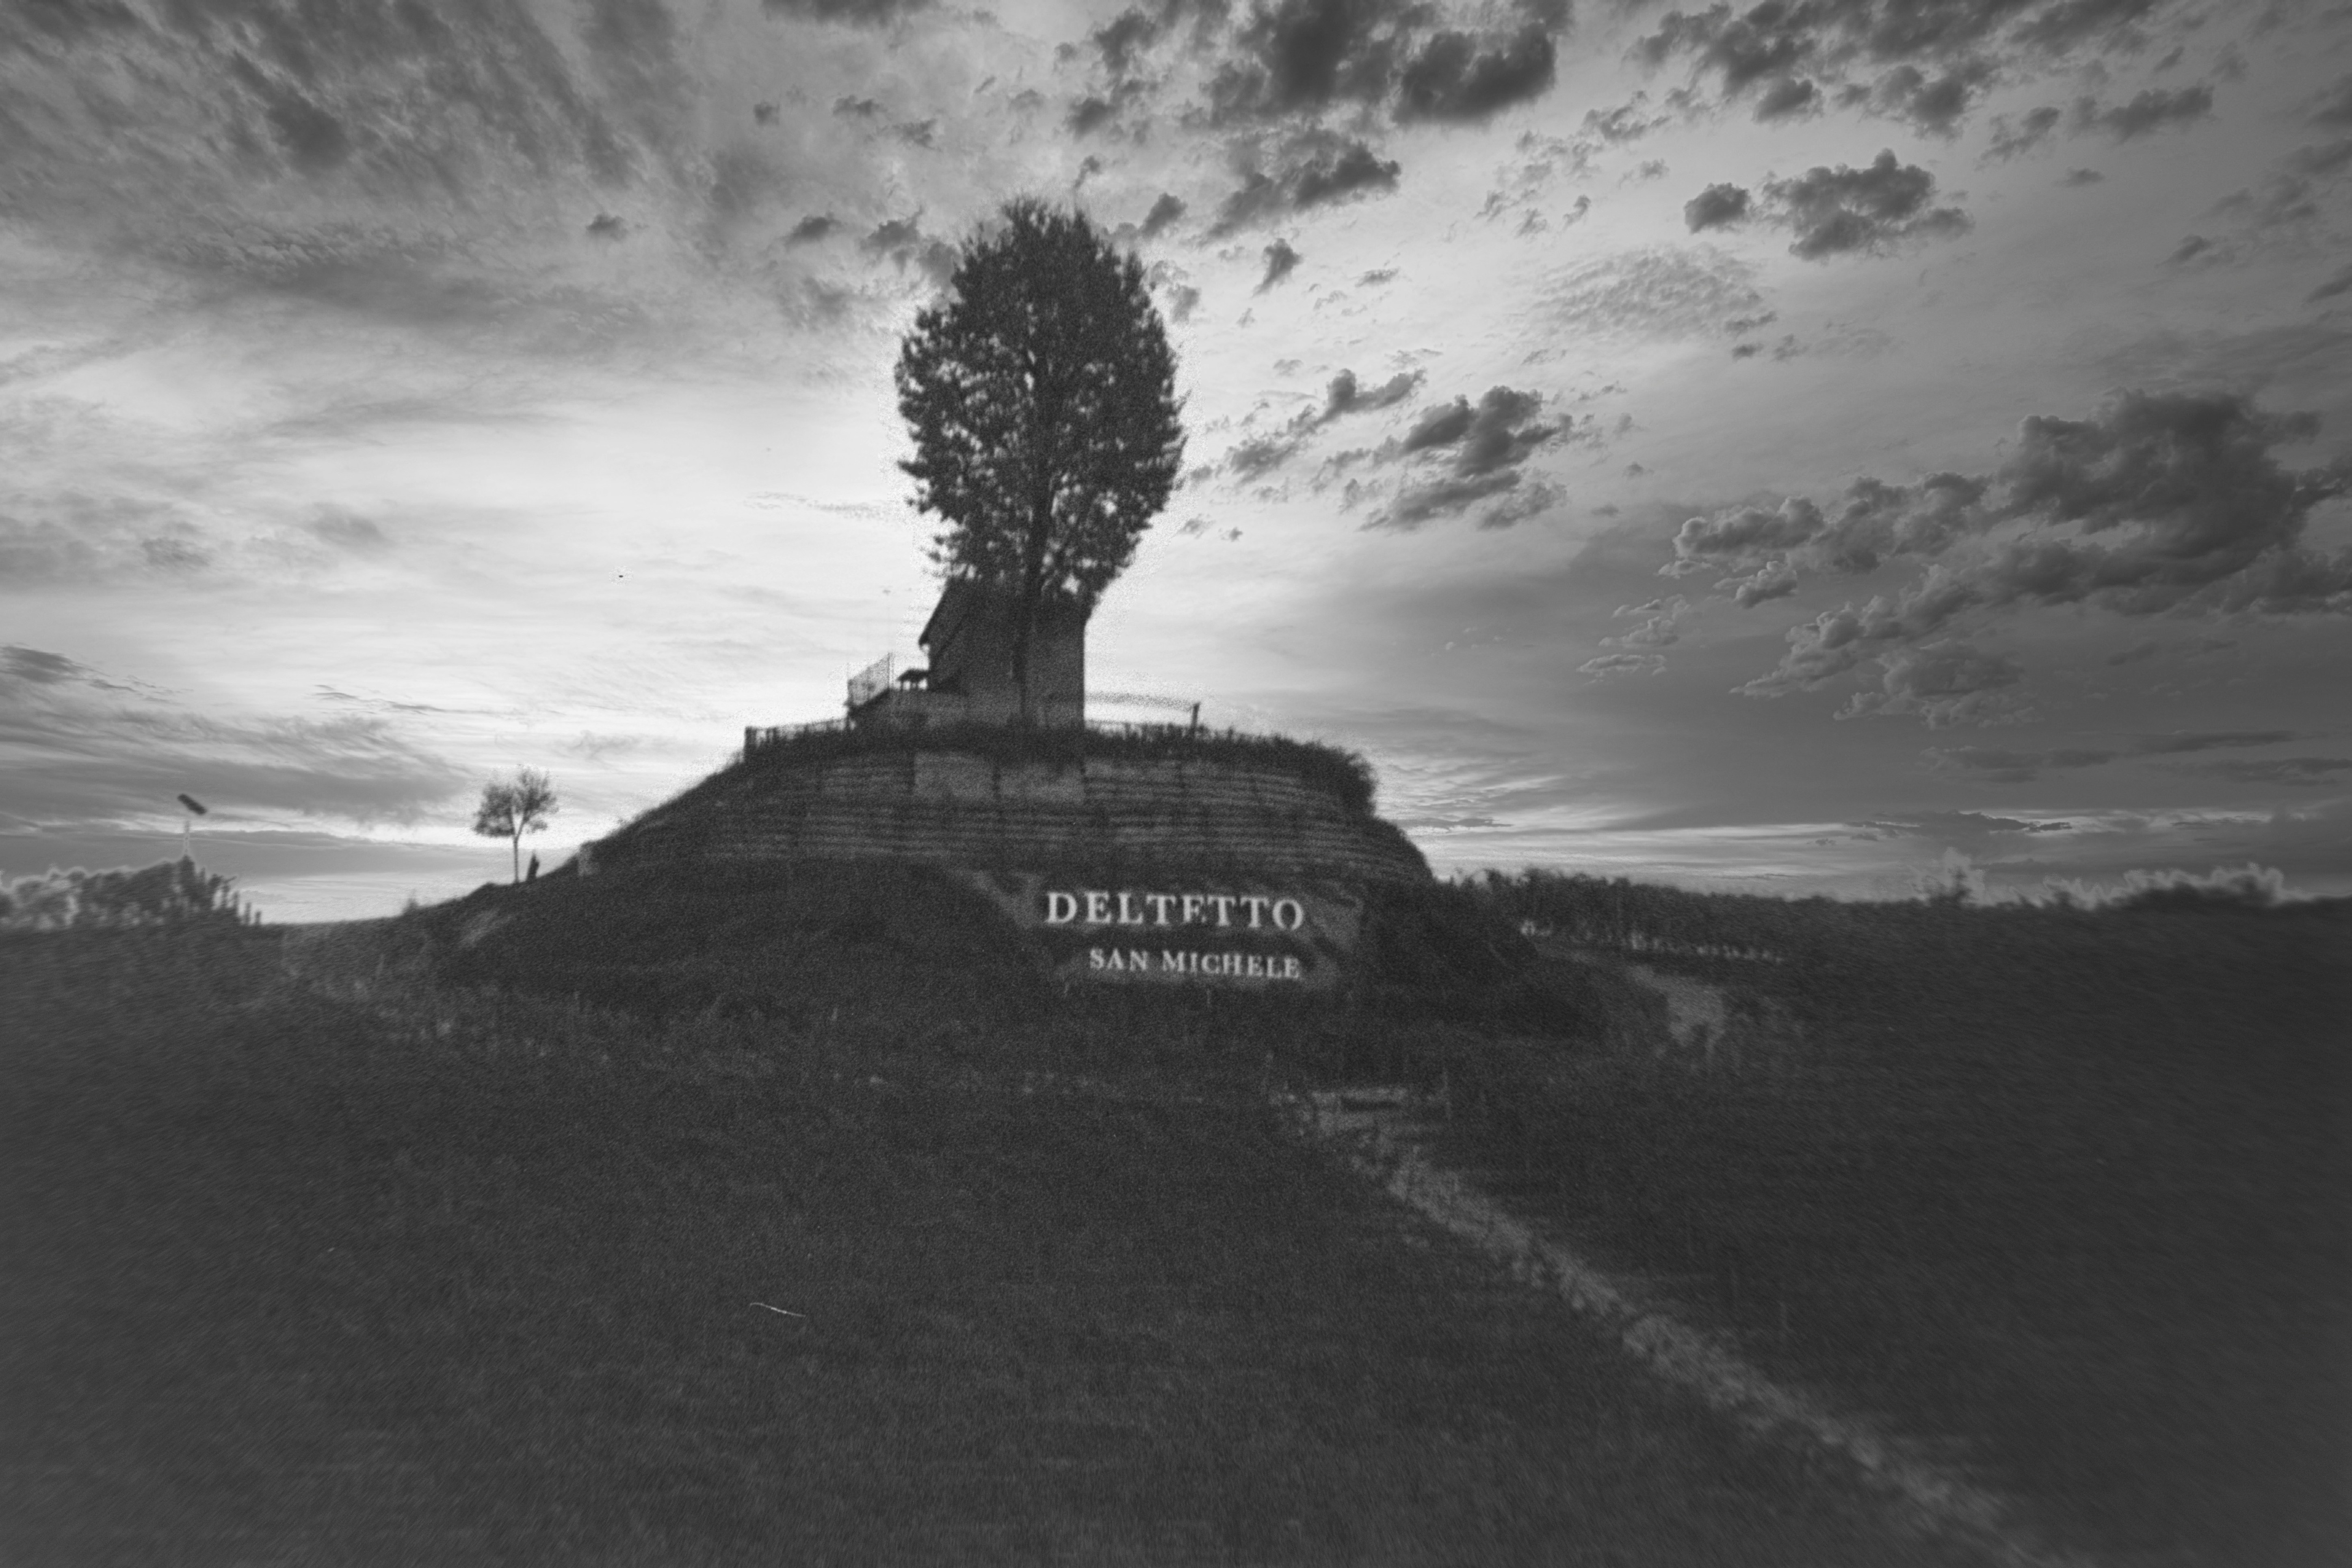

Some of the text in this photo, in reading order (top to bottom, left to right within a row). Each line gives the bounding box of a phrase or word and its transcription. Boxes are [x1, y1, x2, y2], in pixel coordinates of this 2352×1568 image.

[1046, 892, 1304, 931] DELTETTO
[1089, 948, 1301, 979] SAN MICHELE
